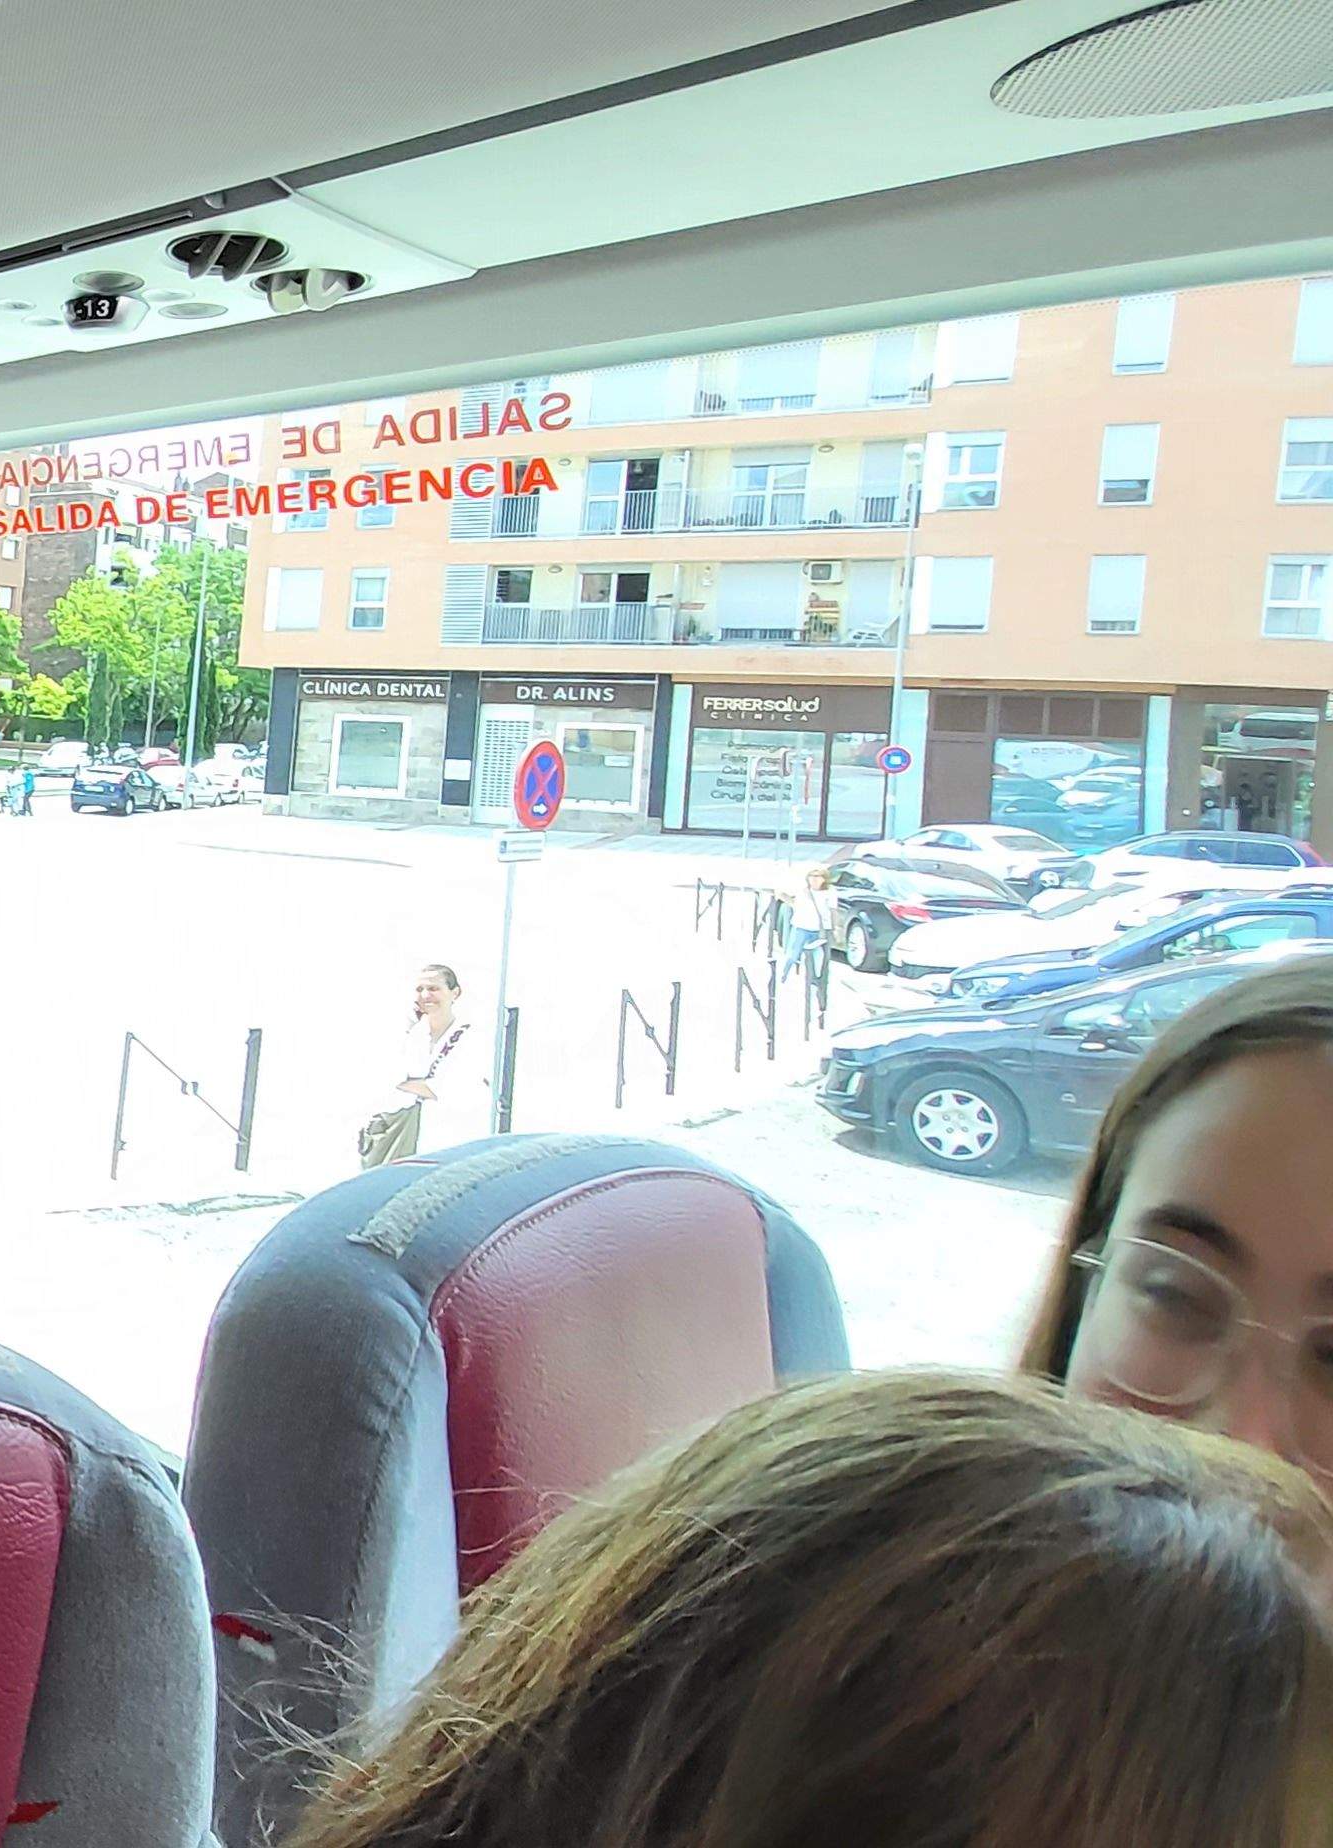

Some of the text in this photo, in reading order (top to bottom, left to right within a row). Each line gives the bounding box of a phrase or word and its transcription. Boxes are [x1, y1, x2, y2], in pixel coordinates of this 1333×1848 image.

[136, 491, 190, 525] DE
[205, 457, 559, 519] EMERGENCIA
[302, 679, 445, 698] CLÍNICA DENTAL
[516, 686, 615, 701] DR. ALINS
